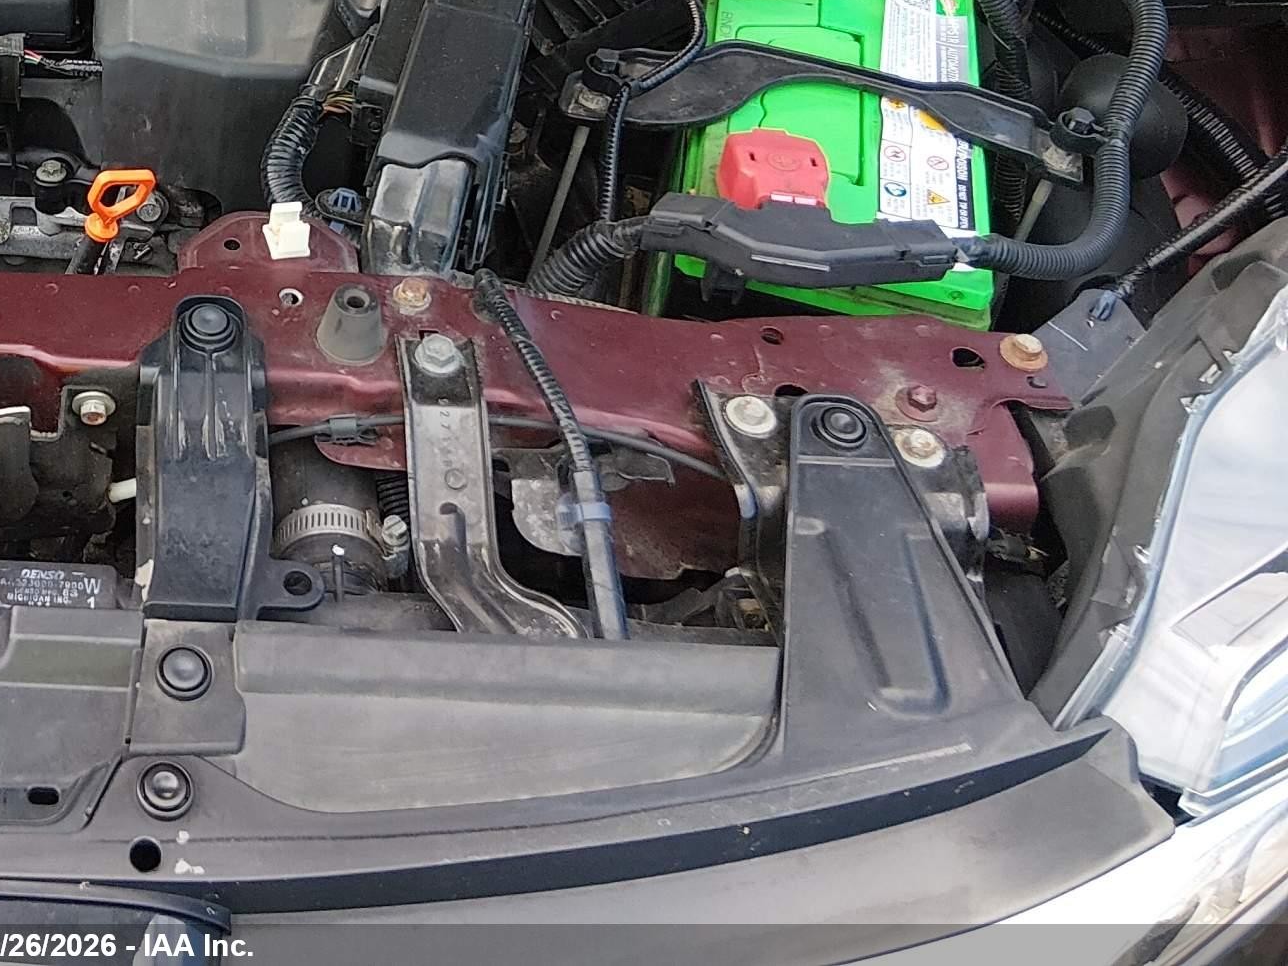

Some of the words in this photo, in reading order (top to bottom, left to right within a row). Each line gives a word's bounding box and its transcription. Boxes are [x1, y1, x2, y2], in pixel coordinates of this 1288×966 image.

[20, 568, 65, 580] DENSO
[83, 577, 102, 595] W
[86, 596, 96, 609] 1
